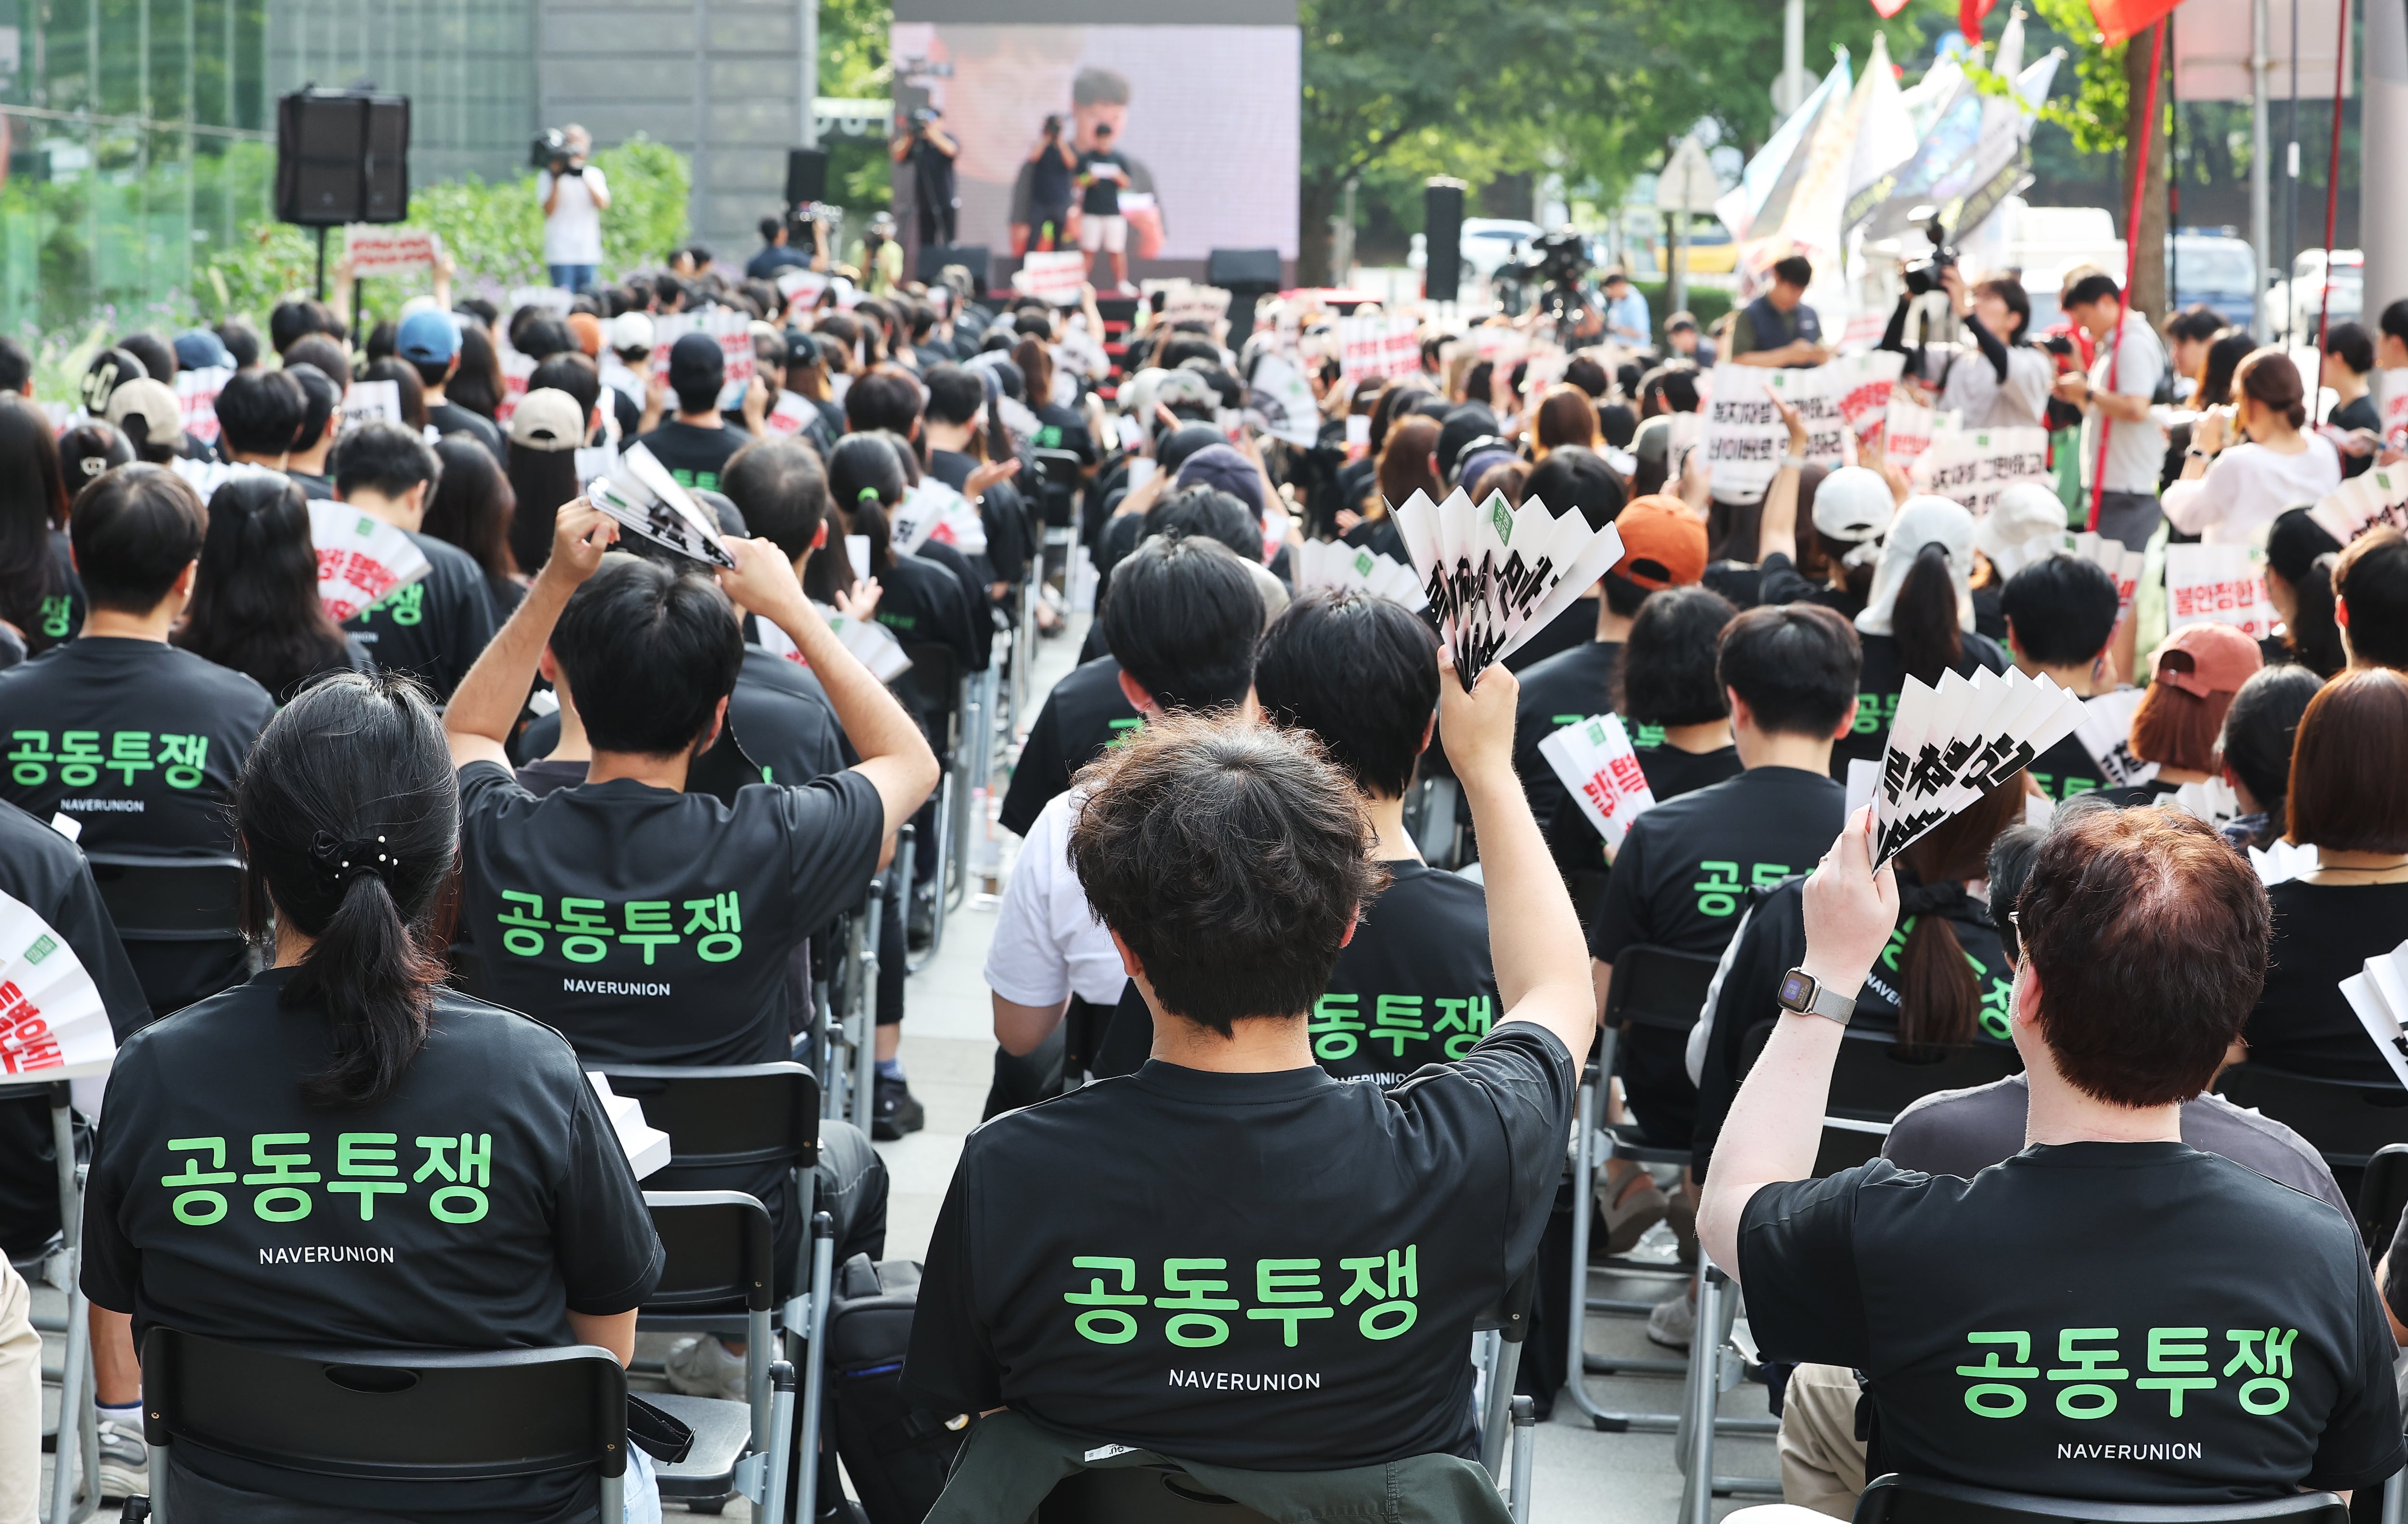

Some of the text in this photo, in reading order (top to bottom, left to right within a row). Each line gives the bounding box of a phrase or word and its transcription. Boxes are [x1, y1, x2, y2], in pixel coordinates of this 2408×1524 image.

[2175, 581, 2253, 616] 불안정한
[8, 730, 209, 789] 공동투쟁
[60, 798, 145, 813] NAVERUNION
[497, 889, 743, 965] 공동투쟁
[563, 978, 670, 996] NAVERUNION
[1309, 993, 1492, 1060] 동투쟁
[161, 1133, 491, 1225] 공동투쟁
[259, 1246, 394, 1264] NAVERUNION
[1064, 1244, 1418, 1347] 공동투쟁
[1169, 1369, 1321, 1391] NAVERUNION
[1956, 1327, 2298, 1419] 공동투쟁
[2057, 1442, 2202, 1460] NAVERUNION
